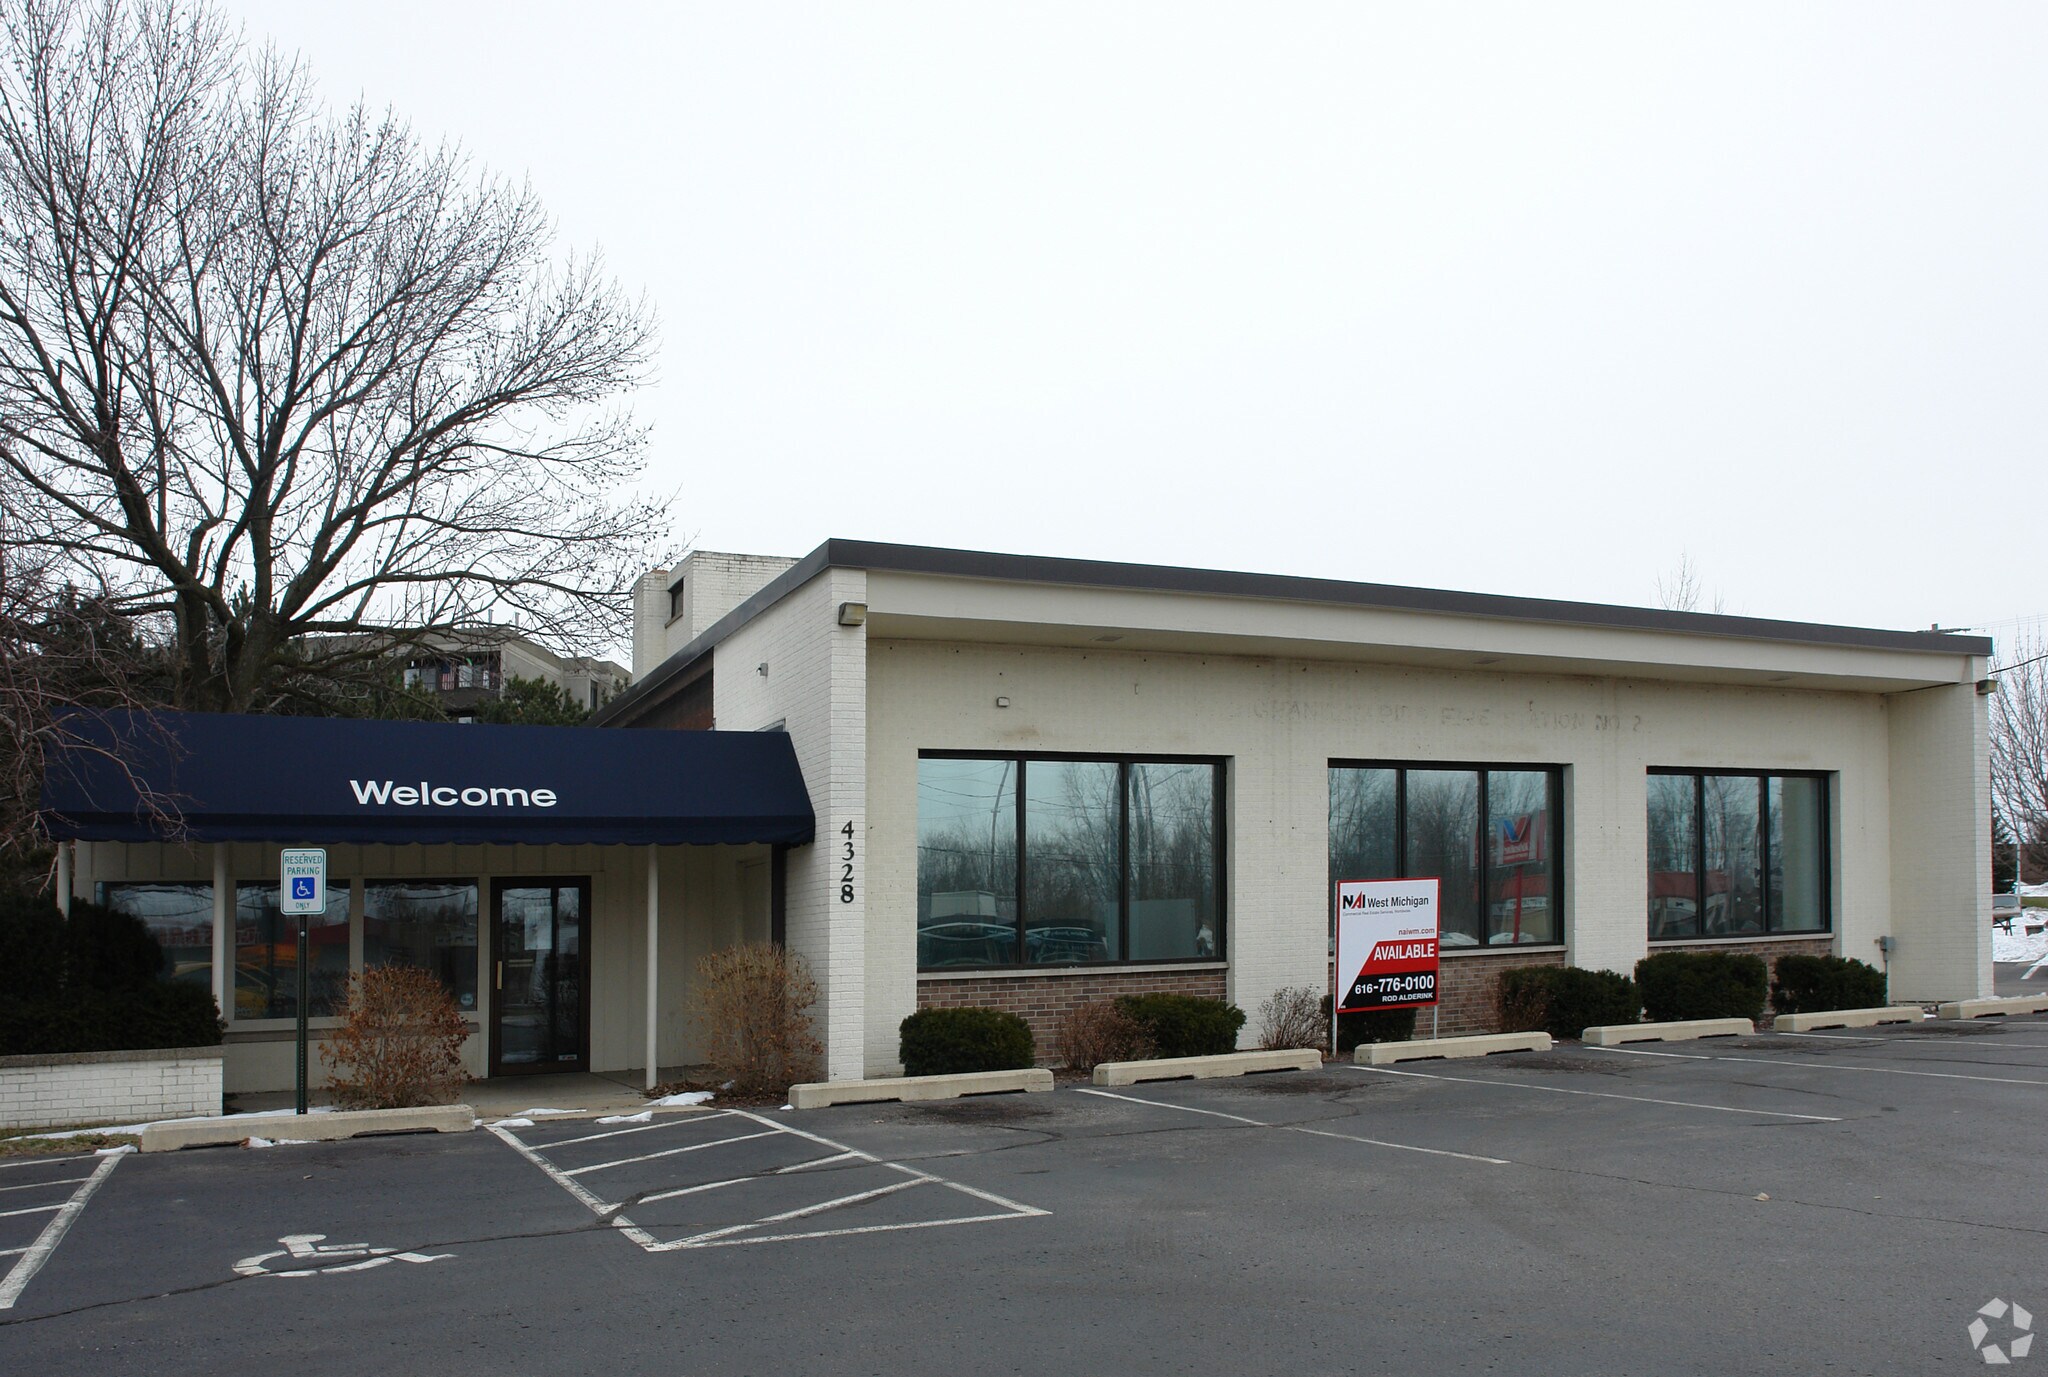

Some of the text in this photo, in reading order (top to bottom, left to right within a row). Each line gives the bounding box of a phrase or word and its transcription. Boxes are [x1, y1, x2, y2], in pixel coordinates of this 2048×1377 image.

[350, 779, 557, 807] Welcome
[284, 856, 323, 864] RESERVED
[840, 820, 855, 904] 4328
[287, 867, 320, 875] PARKING
[1342, 891, 1429, 909] NAI West Michigan
[1398, 928, 1435, 936] naiwm.com
[1373, 943, 1435, 961] AVAILABLE
[1354, 975, 1435, 995] 616-776-0100
[1398, 992, 1434, 1001] ALDERINK
